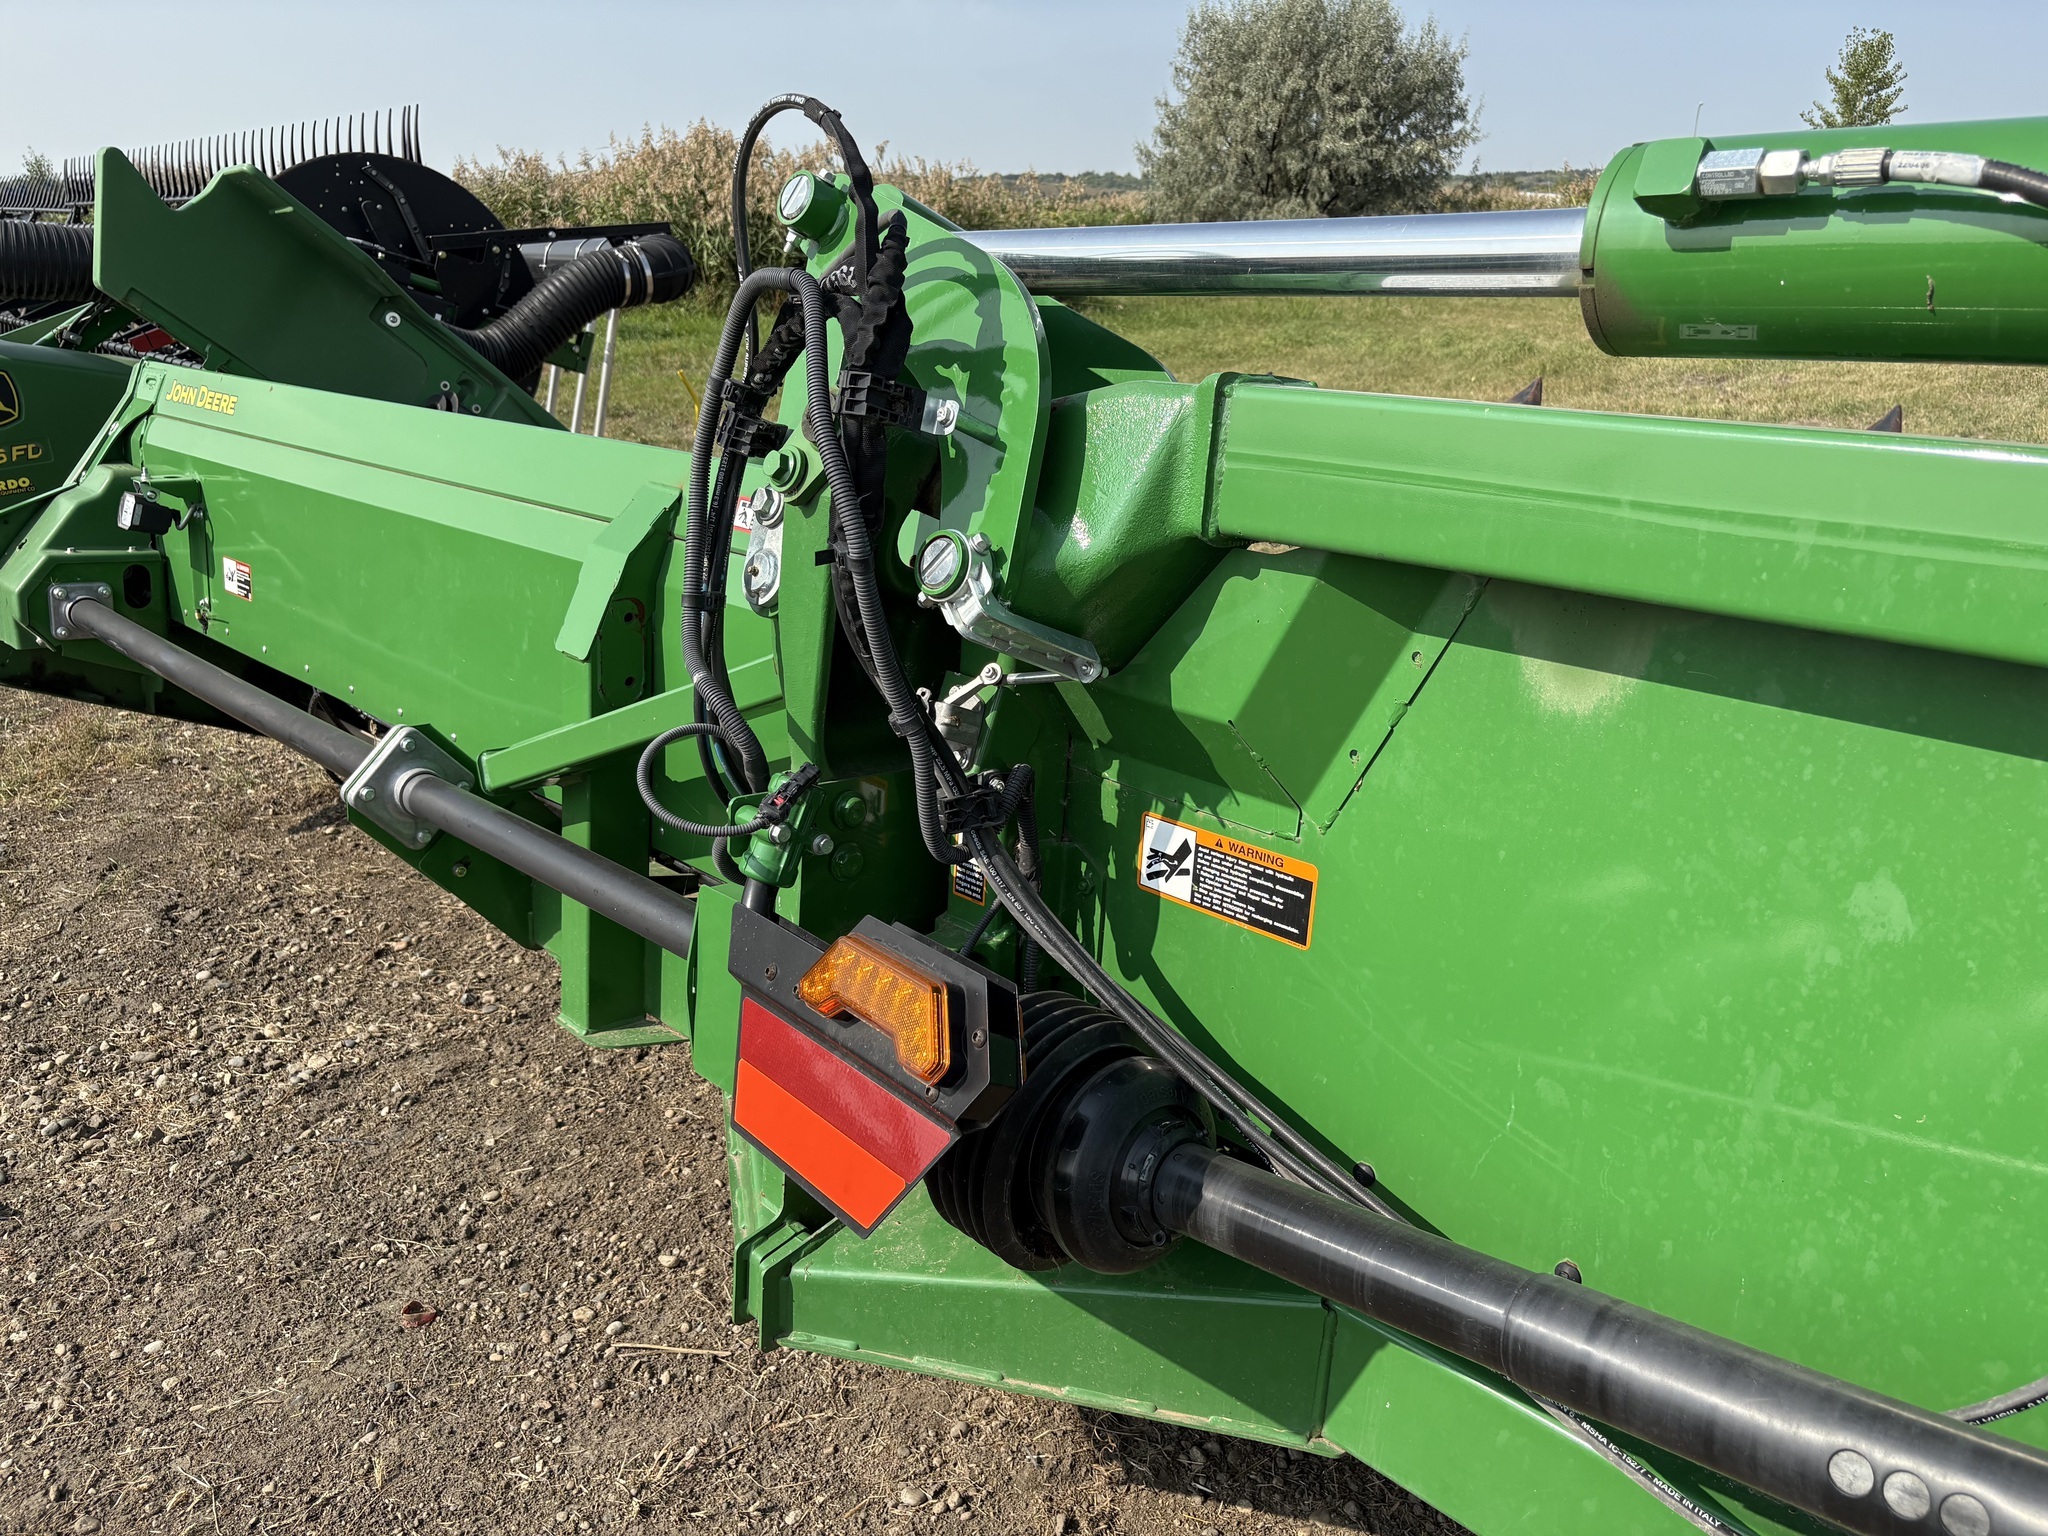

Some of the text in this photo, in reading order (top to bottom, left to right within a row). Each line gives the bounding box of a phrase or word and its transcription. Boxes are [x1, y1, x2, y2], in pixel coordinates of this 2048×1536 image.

[166, 380, 238, 415] JOHN DEERE
[12, 444, 42, 461] FD
[1229, 842, 1284, 868] WARNING
[1581, 1421, 1608, 1446] MSHA
[1608, 1442, 1647, 1475] IC-152/7
[1652, 1477, 1682, 1501] MADE
[1682, 1498, 1693, 1510] IN
[1694, 1506, 1722, 1528] ITALY
